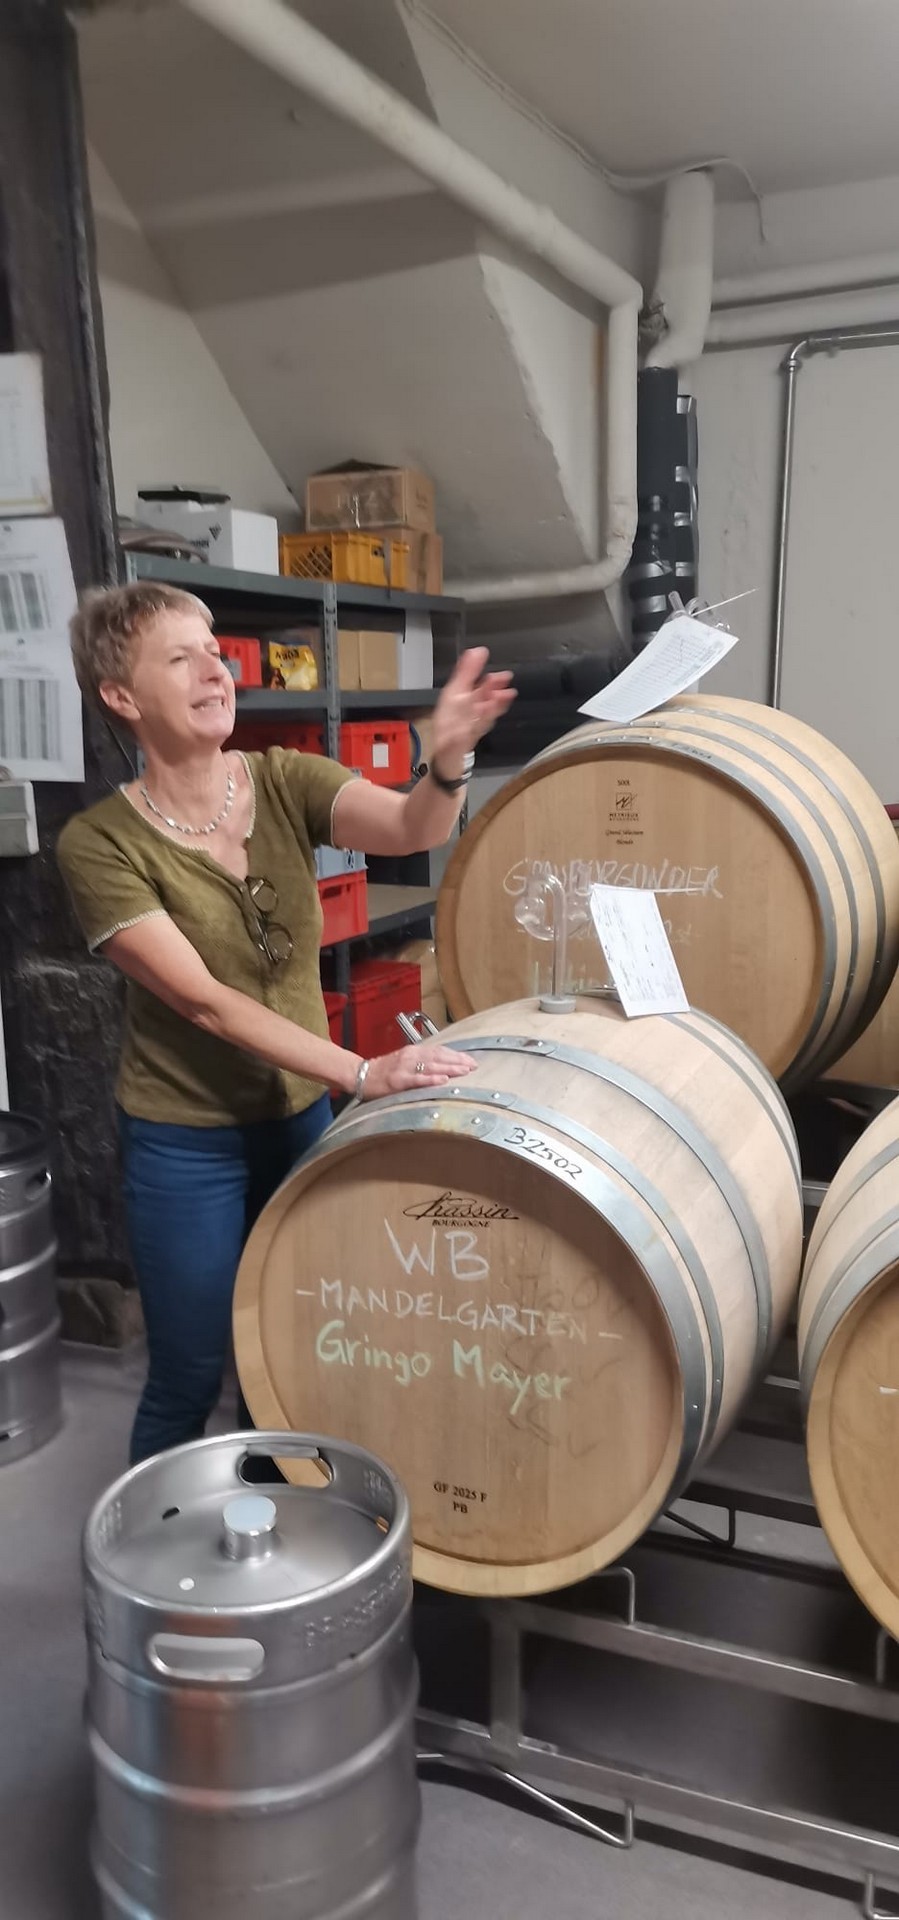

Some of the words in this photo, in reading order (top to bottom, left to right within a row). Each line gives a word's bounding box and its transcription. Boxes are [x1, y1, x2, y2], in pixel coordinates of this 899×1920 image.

[503, 1126, 584, 1181] B2502
[402, 1191, 520, 1220] Chassin
[431, 1219, 490, 1228] BOURGOGNE
[383, 1218, 491, 1281] WB
[316, 1319, 432, 1387] Gringo
[453, 1338, 572, 1415] Mayer
[433, 1480, 449, 1494] GF
[452, 1485, 477, 1500] 2025
[453, 1500, 469, 1514] PB
